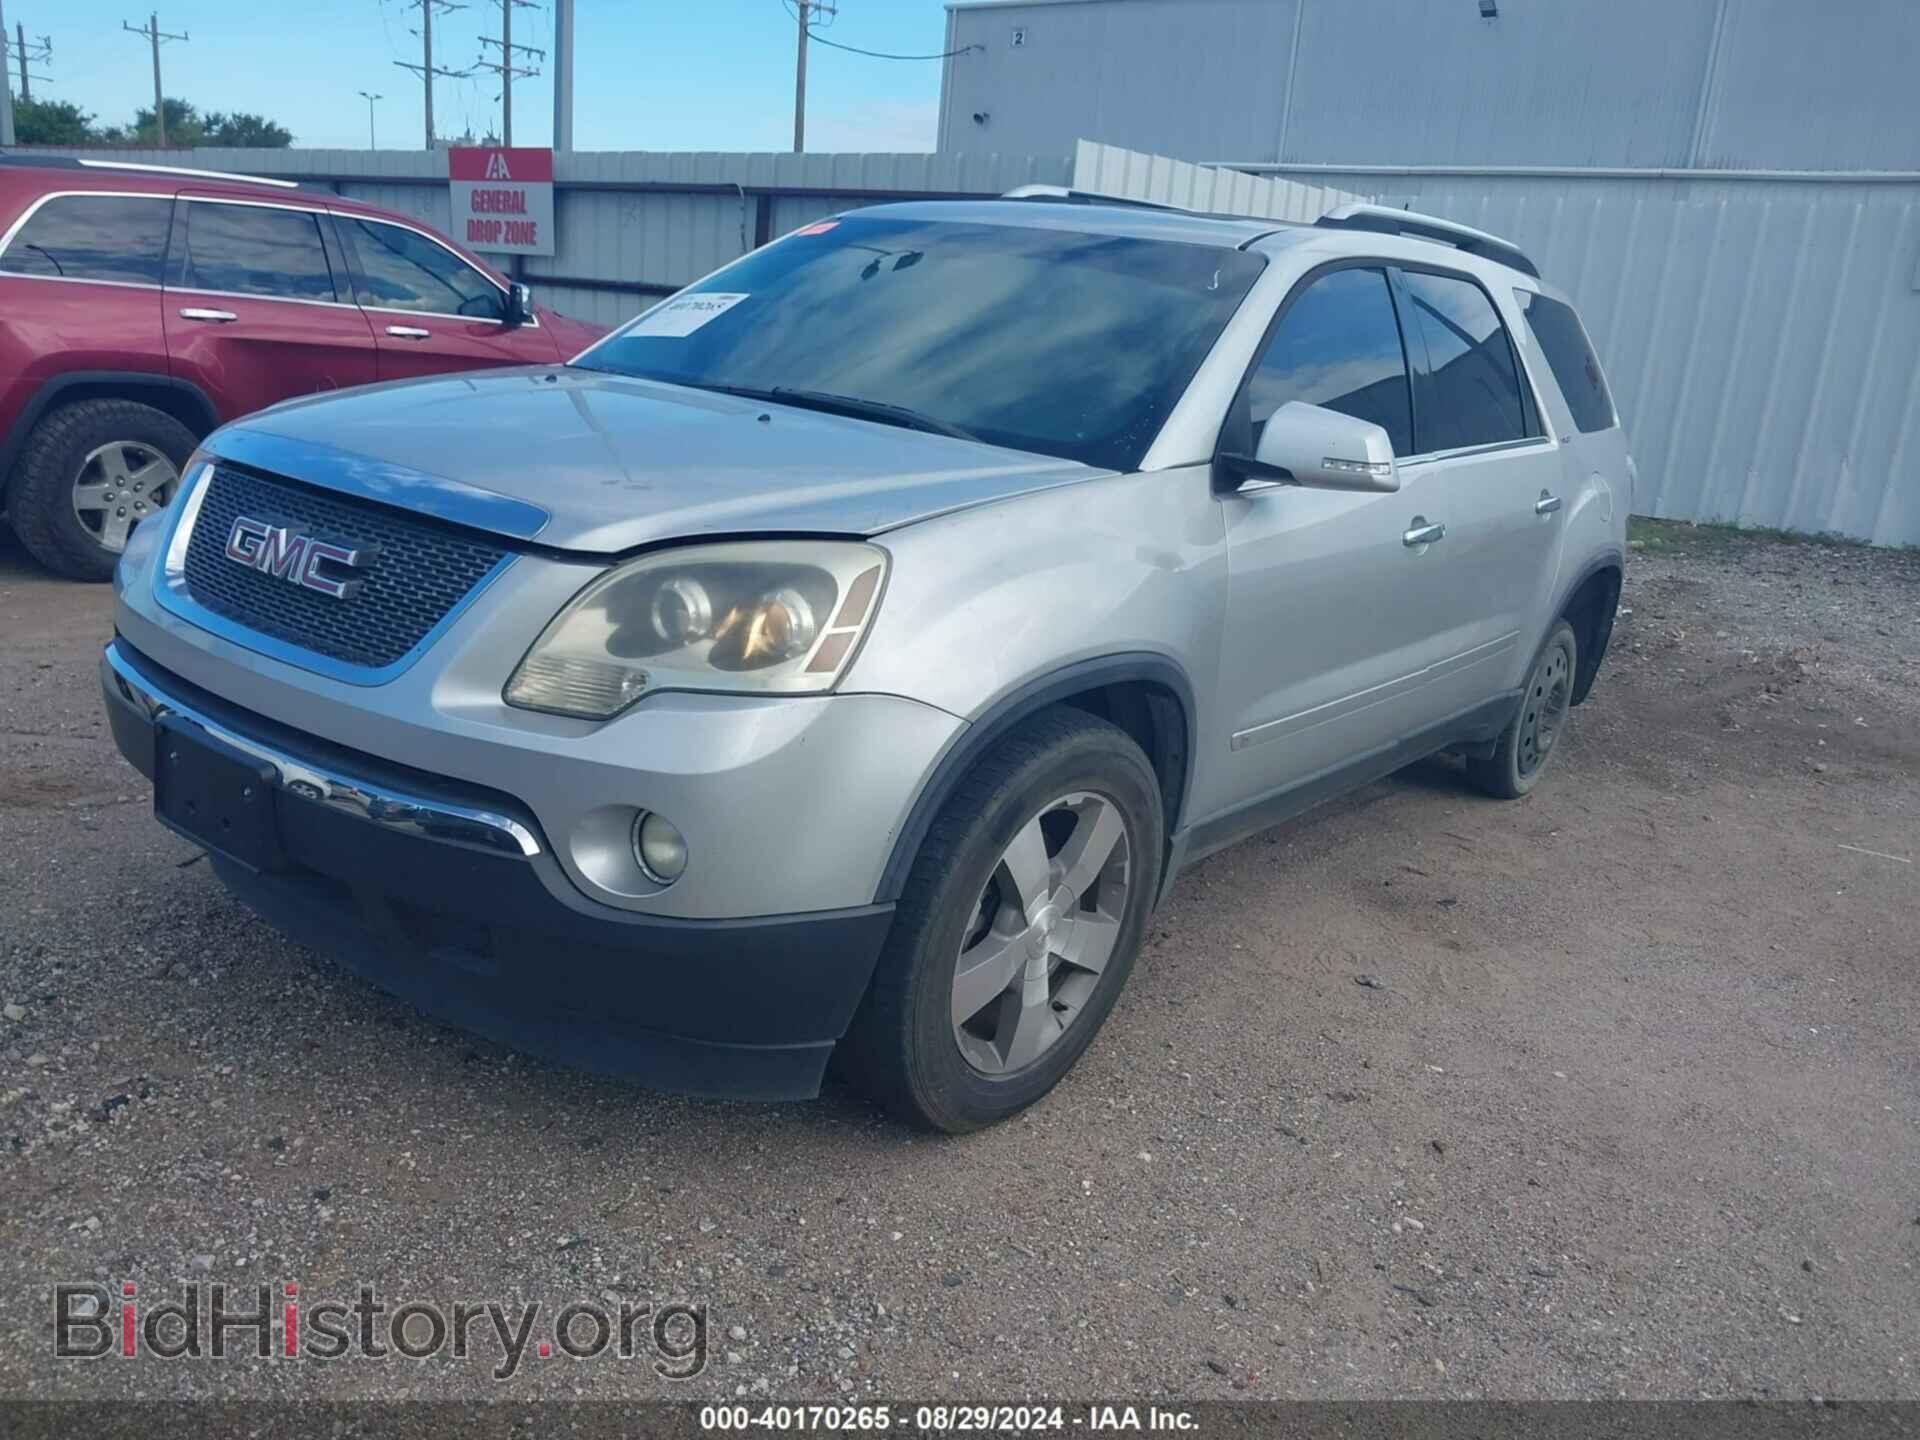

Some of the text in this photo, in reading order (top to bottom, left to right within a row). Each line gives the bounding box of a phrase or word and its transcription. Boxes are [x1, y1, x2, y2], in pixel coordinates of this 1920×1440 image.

[1015, 32, 1023, 45] 2
[471, 189, 527, 213] GENERAL
[466, 219, 537, 245] DROP ZONE
[225, 516, 358, 599] GMC
